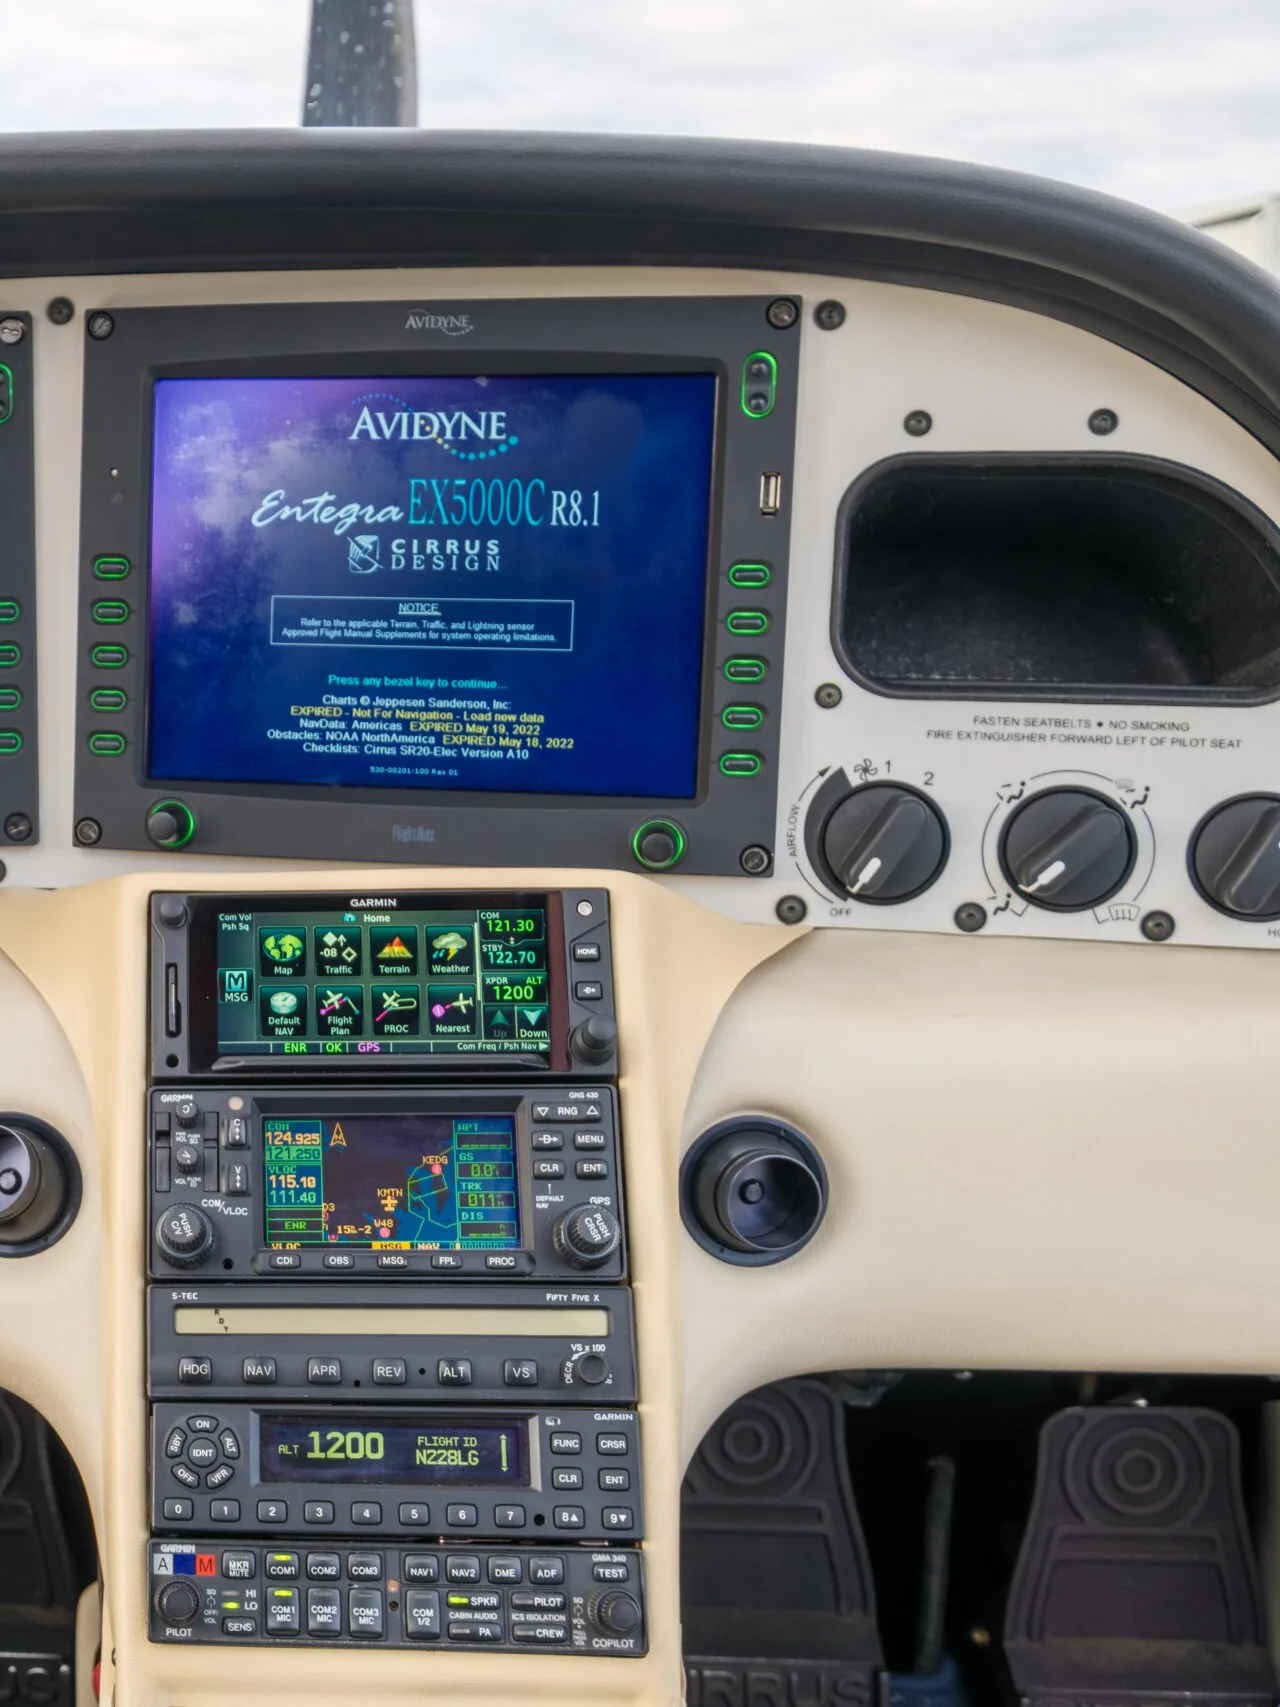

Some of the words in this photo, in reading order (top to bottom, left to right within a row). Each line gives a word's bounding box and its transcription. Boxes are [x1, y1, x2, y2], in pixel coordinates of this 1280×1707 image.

[405, 314, 469, 329] AVIDYNE
[349, 406, 507, 440] AVIDYNE
[252, 490, 403, 535] Entegra
[408, 478, 545, 526] EX5000C
[551, 490, 599, 526] R8.1
[391, 539, 500, 554] CIRRUS
[391, 554, 500, 571] DESIGN
[398, 602, 439, 613] NOTICE
[328, 675, 360, 685] Press
[363, 677, 381, 688] any
[384, 677, 412, 687] bezel
[416, 678, 435, 689] key
[438, 678, 449, 688] to
[322, 695, 357, 705] Charts
[373, 697, 425, 707] Jeppesen
[428, 697, 490, 710] Sanderson,
[291, 706, 342, 716] EXPIRED
[352, 709, 371, 717] Not
[374, 709, 392, 718] For
[396, 710, 453, 721] Navigation
[463, 711, 491, 721] Load
[520, 713, 544, 723] data
[300, 718, 347, 728] NavData:
[352, 720, 402, 730] Americas
[411, 722, 462, 732] EXPIRED
[466, 723, 488, 734] May
[493, 724, 509, 735] 19,
[513, 725, 540, 735] 2022
[973, 715, 1019, 726] FASTEN
[1024, 718, 1091, 729] SEATBELTS
[1109, 720, 1127, 729] NO
[1131, 721, 1189, 731] SMOKING
[267, 729, 321, 739] Obstacles:
[326, 731, 359, 741] NOAA
[362, 732, 435, 744] NorthAmerica
[443, 735, 495, 745] EXPIRED
[499, 737, 521, 747] May
[526, 738, 542, 748] 18,
[546, 738, 574, 748] 2022
[927, 729, 952, 739] FIRE
[957, 730, 1046, 742] EXTINGUISHER
[1051, 733, 1112, 745] FORWARD
[1117, 735, 1146, 746] LEFT
[1150, 737, 1167, 746] OF
[1171, 737, 1206, 748] PILOT
[1211, 739, 1241, 749] SEAT
[303, 742, 360, 753] Checklists:
[364, 744, 397, 755] Cirrus
[400, 746, 457, 757] SR20-Elec
[461, 747, 503, 758] Version
[507, 749, 528, 759] A10
[884, 760, 892, 773] 1
[923, 771, 934, 785] 2
[350, 899, 396, 907] GARMIN
[830, 908, 852, 917] OFF
[363, 914, 390, 922] Home
[486, 920, 534, 932] 121.30
[488, 952, 536, 964] 122.70
[274, 967, 292, 975] Map
[324, 966, 352, 974] Traffic
[380, 965, 410, 973] Terrain
[432, 965, 469, 973] Weather
[493, 986, 534, 1000] 1200
[268, 1017, 300, 1025] Default
[327, 1017, 352, 1025] Flight
[275, 1027, 294, 1035] NAV
[331, 1027, 349, 1035] Plan
[520, 1030, 547, 1038] Down
[284, 1043, 307, 1052] ENR
[358, 1043, 380, 1052] GPS
[558, 1107, 578, 1115] RNG
[266, 1132, 320, 1145] 124.925
[577, 1135, 603, 1143] MENU
[422, 1156, 448, 1164] KEDG
[540, 1164, 559, 1172] CLR
[584, 1164, 601, 1172] ENT
[277, 1257, 292, 1265] CDI
[329, 1256, 349, 1265] OBS
[382, 1256, 404, 1265] MSG
[439, 1257, 455, 1265] FPL
[489, 1257, 514, 1265] PROC
[172, 1292, 198, 1300] S-TEC
[183, 1364, 208, 1375] HDG
[247, 1364, 272, 1376] NAV
[312, 1365, 337, 1377] APR
[377, 1366, 401, 1378] REV
[443, 1366, 465, 1378] ALT
[513, 1368, 530, 1378] VS
[196, 1420, 209, 1428] ON
[307, 1431, 384, 1459] 1200
[418, 1437, 459, 1446] FLIGHT
[463, 1437, 477, 1447] ID
[554, 1439, 579, 1447] FUNC
[601, 1440, 626, 1449] CRSR
[193, 1449, 212, 1457] IDNT
[416, 1450, 479, 1466] N228LG
[559, 1474, 577, 1483] CLR
[606, 1476, 623, 1484] ENT
[270, 1567, 295, 1575] COM1
[311, 1567, 336, 1575] COM2
[352, 1567, 378, 1575] COM3
[410, 1568, 433, 1576] NAV1
[452, 1569, 475, 1577] NAV2
[495, 1569, 515, 1577] DME
[537, 1569, 557, 1578] ADF
[599, 1569, 624, 1578] TEST
[471, 1597, 497, 1606] SPKR
[534, 1598, 562, 1607] PILOT
[228, 1623, 252, 1631] SENS
[166, 1628, 192, 1636] PILOT
[536, 1629, 563, 1637] CREW
[593, 1639, 634, 1648] COPILOT
